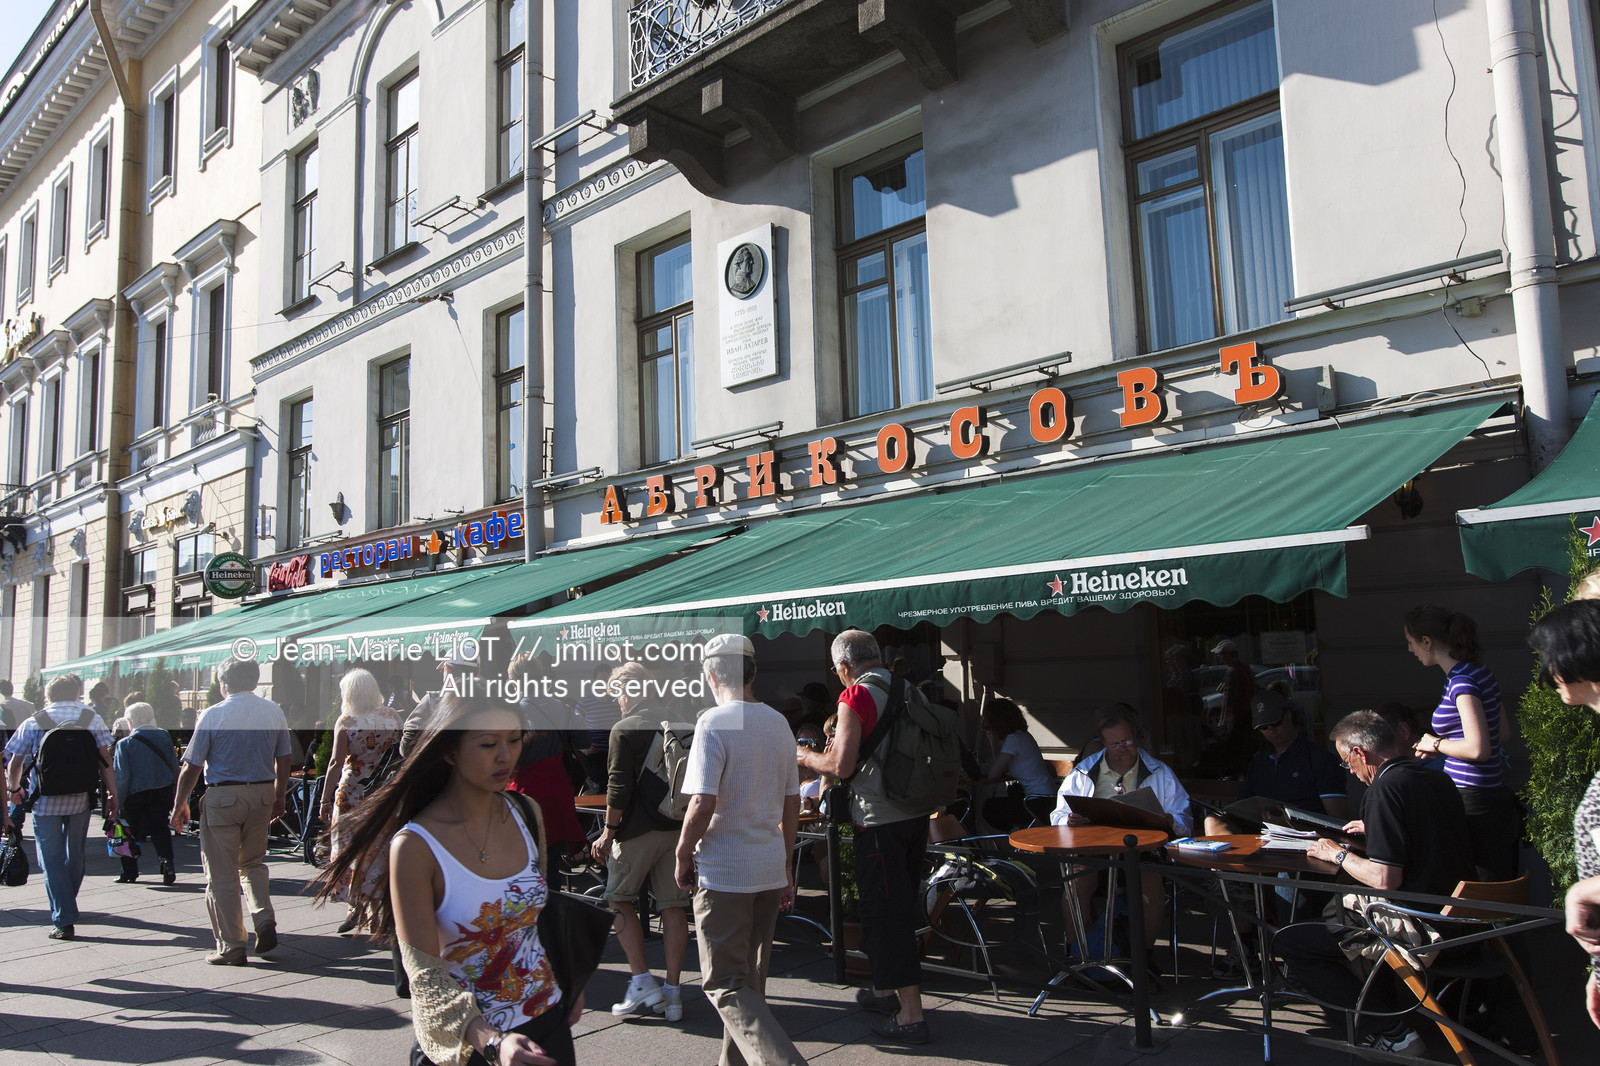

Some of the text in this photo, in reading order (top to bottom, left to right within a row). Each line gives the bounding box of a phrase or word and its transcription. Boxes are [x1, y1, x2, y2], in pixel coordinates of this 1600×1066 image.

[600, 341, 1281, 525] АБРИКОСОВЪ
[320, 510, 524, 579] ресторан кафе
[212, 571, 251, 579] Heineken
[1070, 566, 1188, 595] Heineken
[771, 599, 847, 622] Heineken
[897, 588, 1176, 618] ЧРЕЗМЕРНОЕ УПОТРЕБЛЕНИЕ ПИВА ВРЕДИТ ВАШЕМУ ЗДОРОВЬЮ
[570, 622, 621, 640] Heineken
